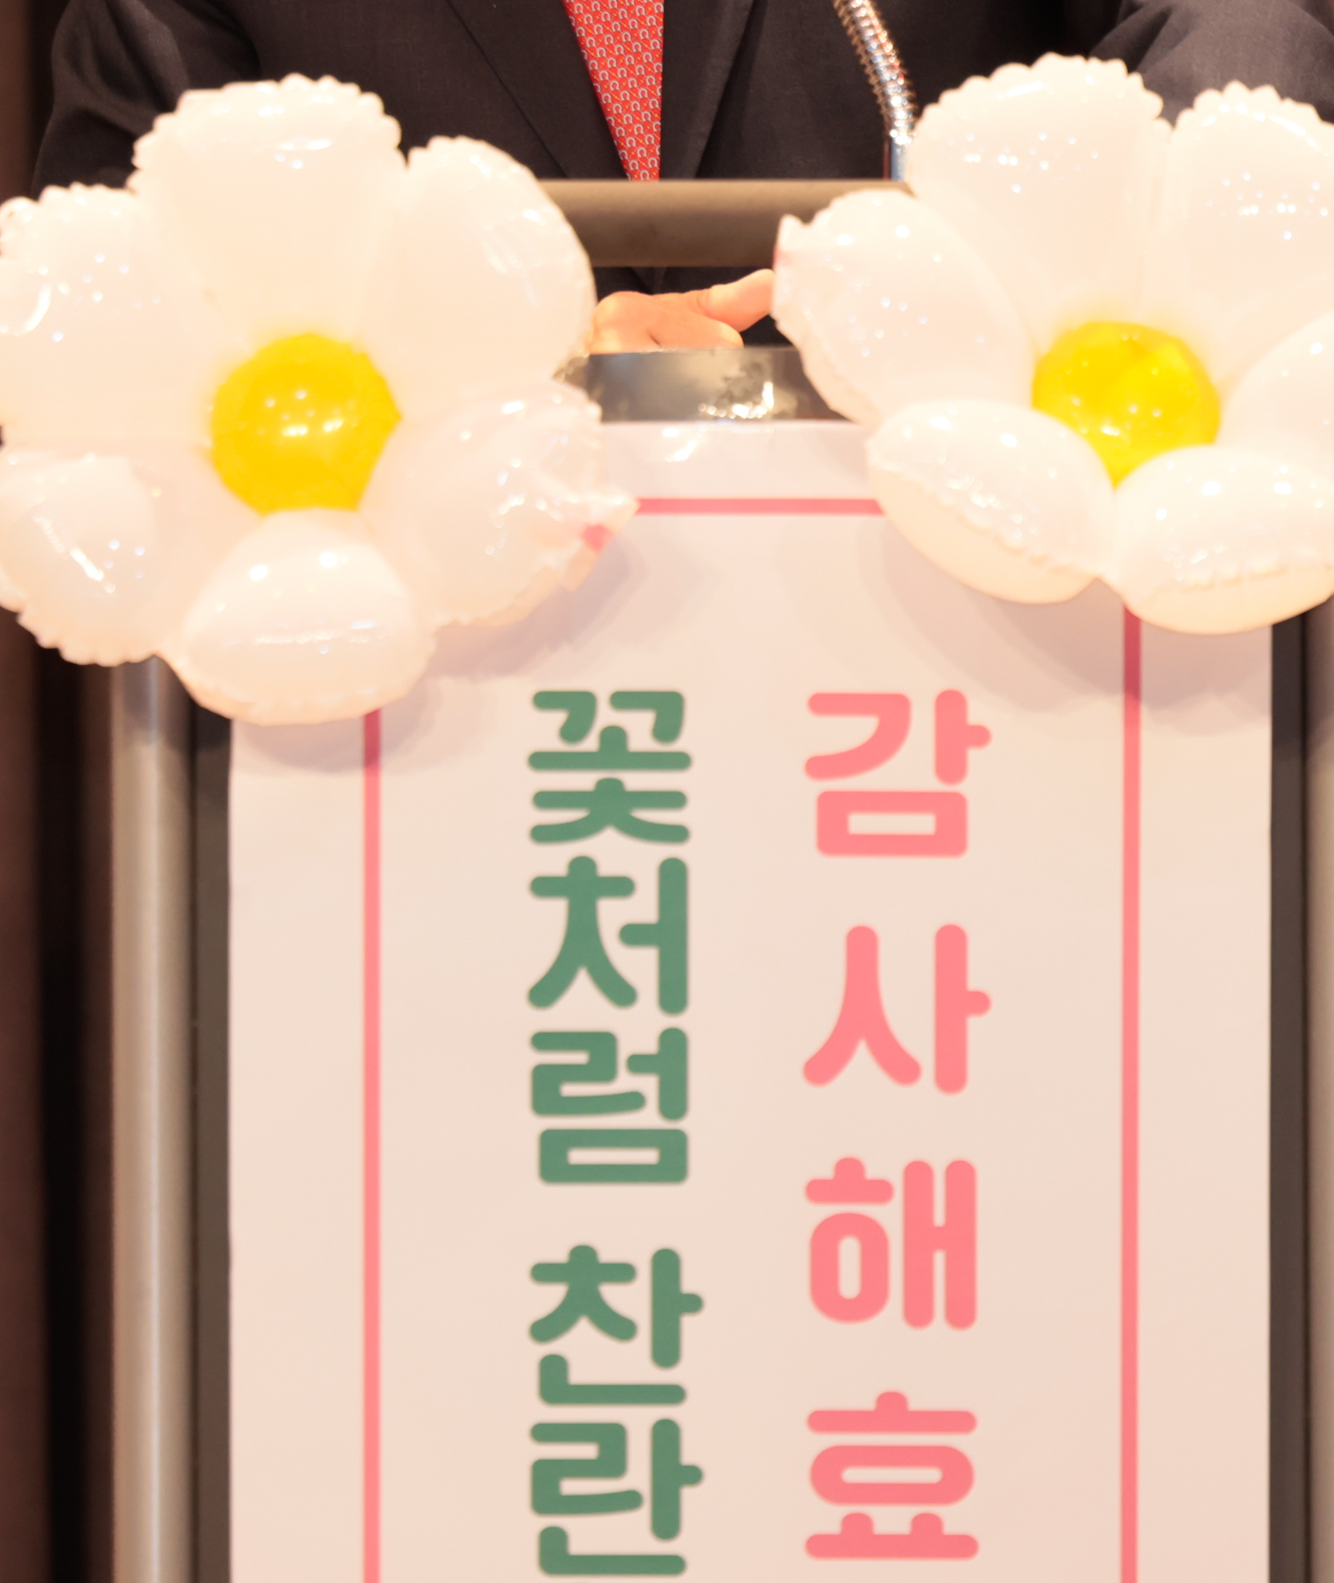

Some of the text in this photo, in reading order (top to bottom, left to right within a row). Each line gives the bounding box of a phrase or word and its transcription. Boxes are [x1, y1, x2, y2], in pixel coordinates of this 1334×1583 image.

[528, 690, 704, 1575] 꽃처럼 찬란
[803, 689, 991, 1560] 감사해효
